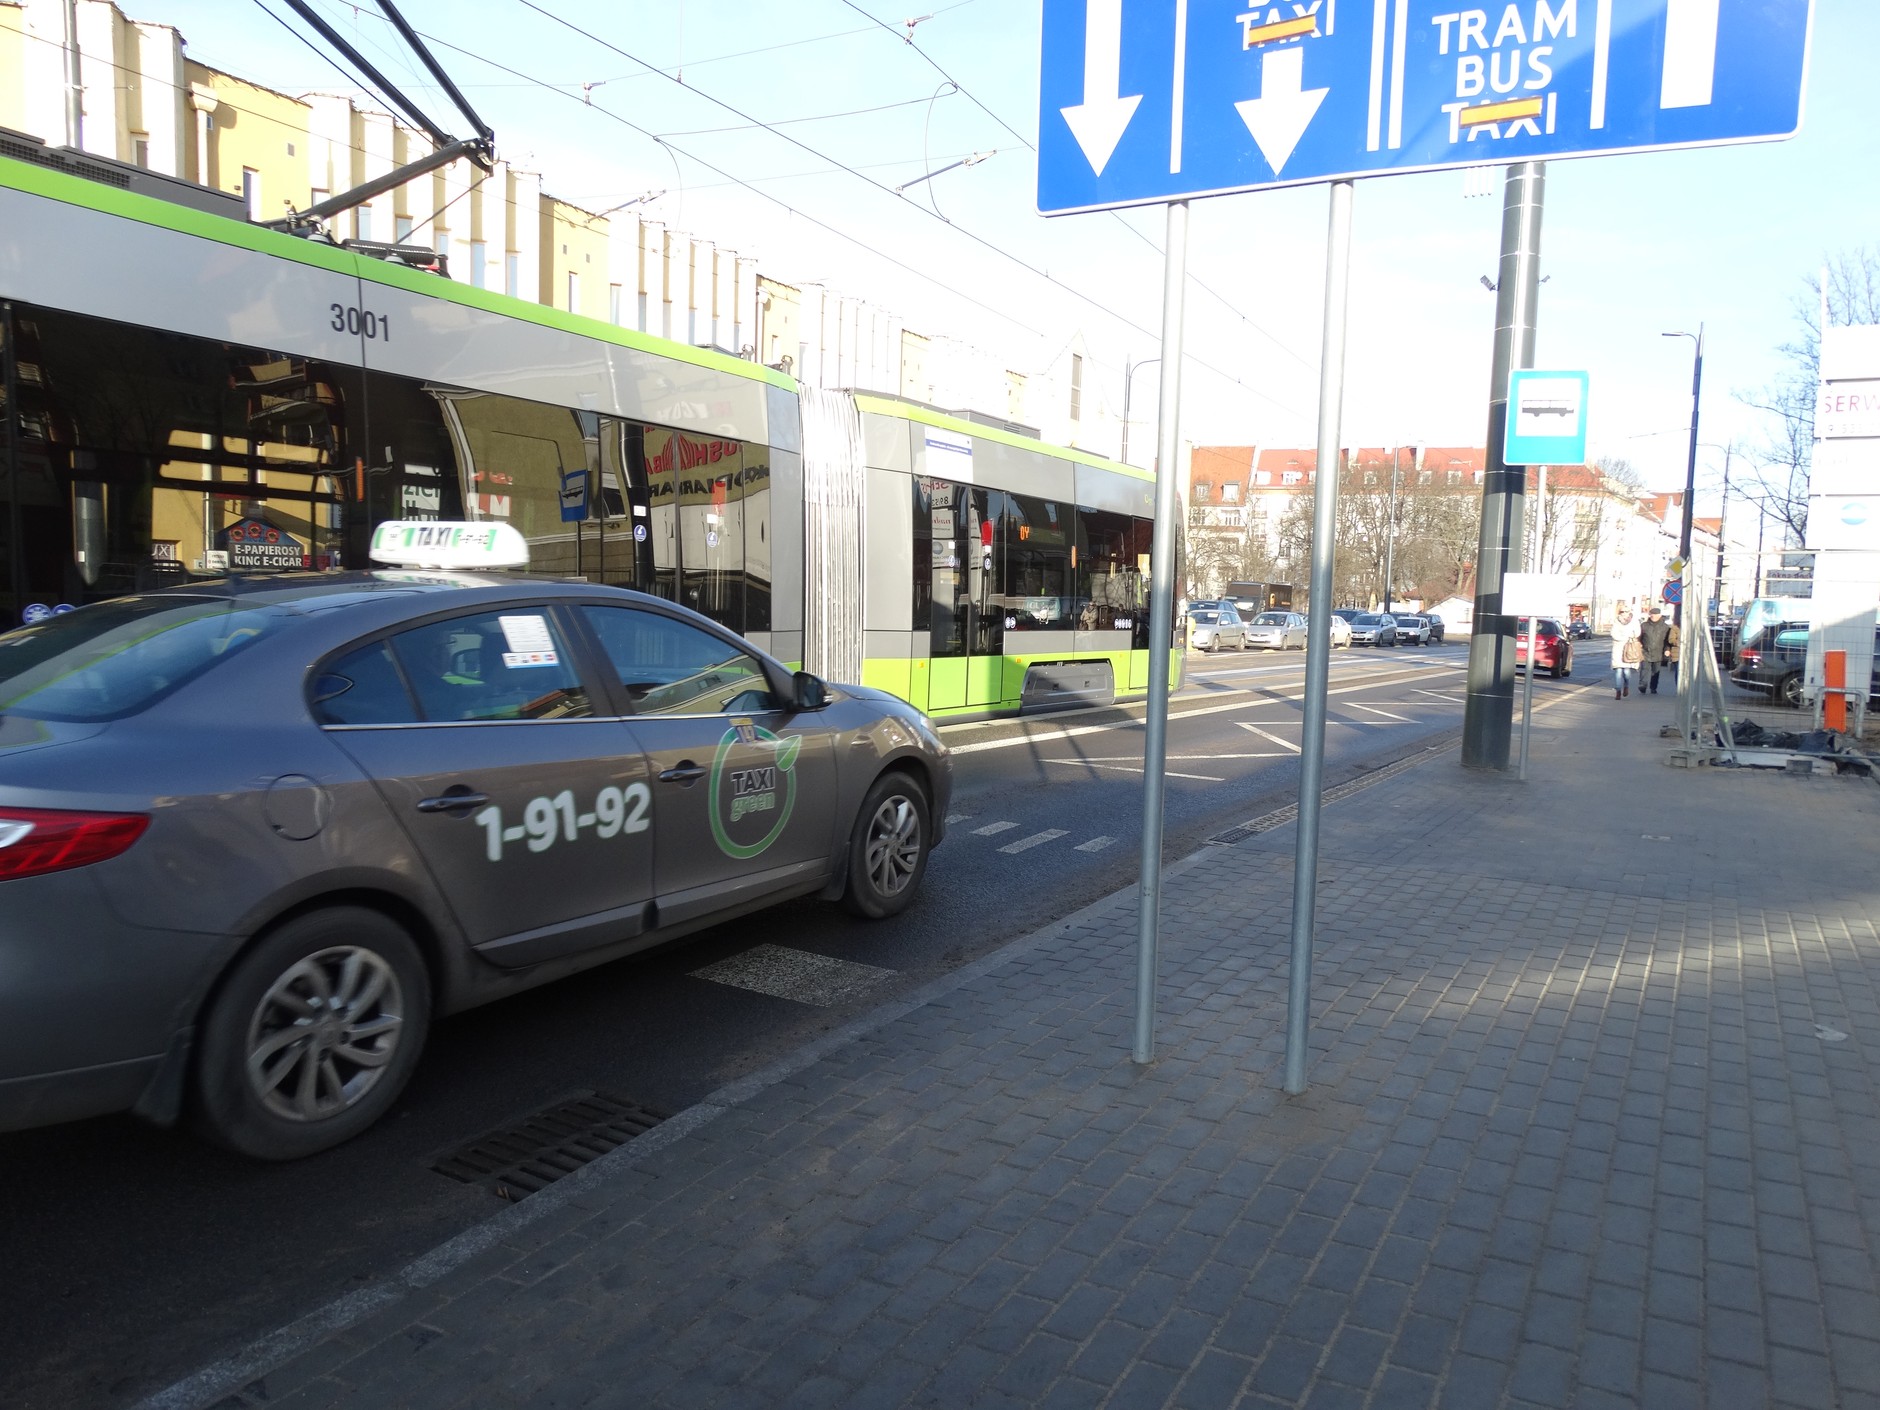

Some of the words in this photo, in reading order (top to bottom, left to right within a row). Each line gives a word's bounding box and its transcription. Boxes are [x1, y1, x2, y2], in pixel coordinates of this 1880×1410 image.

[1431, 0, 1577, 55] TRAM
[1456, 46, 1553, 98] BUS
[331, 303, 389, 342] 3001
[235, 544, 301, 557] E-PAPIEROSY
[417, 527, 453, 548] TAXI
[234, 555, 261, 566] KING
[263, 556, 303, 567] E-CIGAR
[730, 766, 776, 795] TAXI
[475, 782, 651, 862] 1-91-92
[730, 792, 775, 823] green
